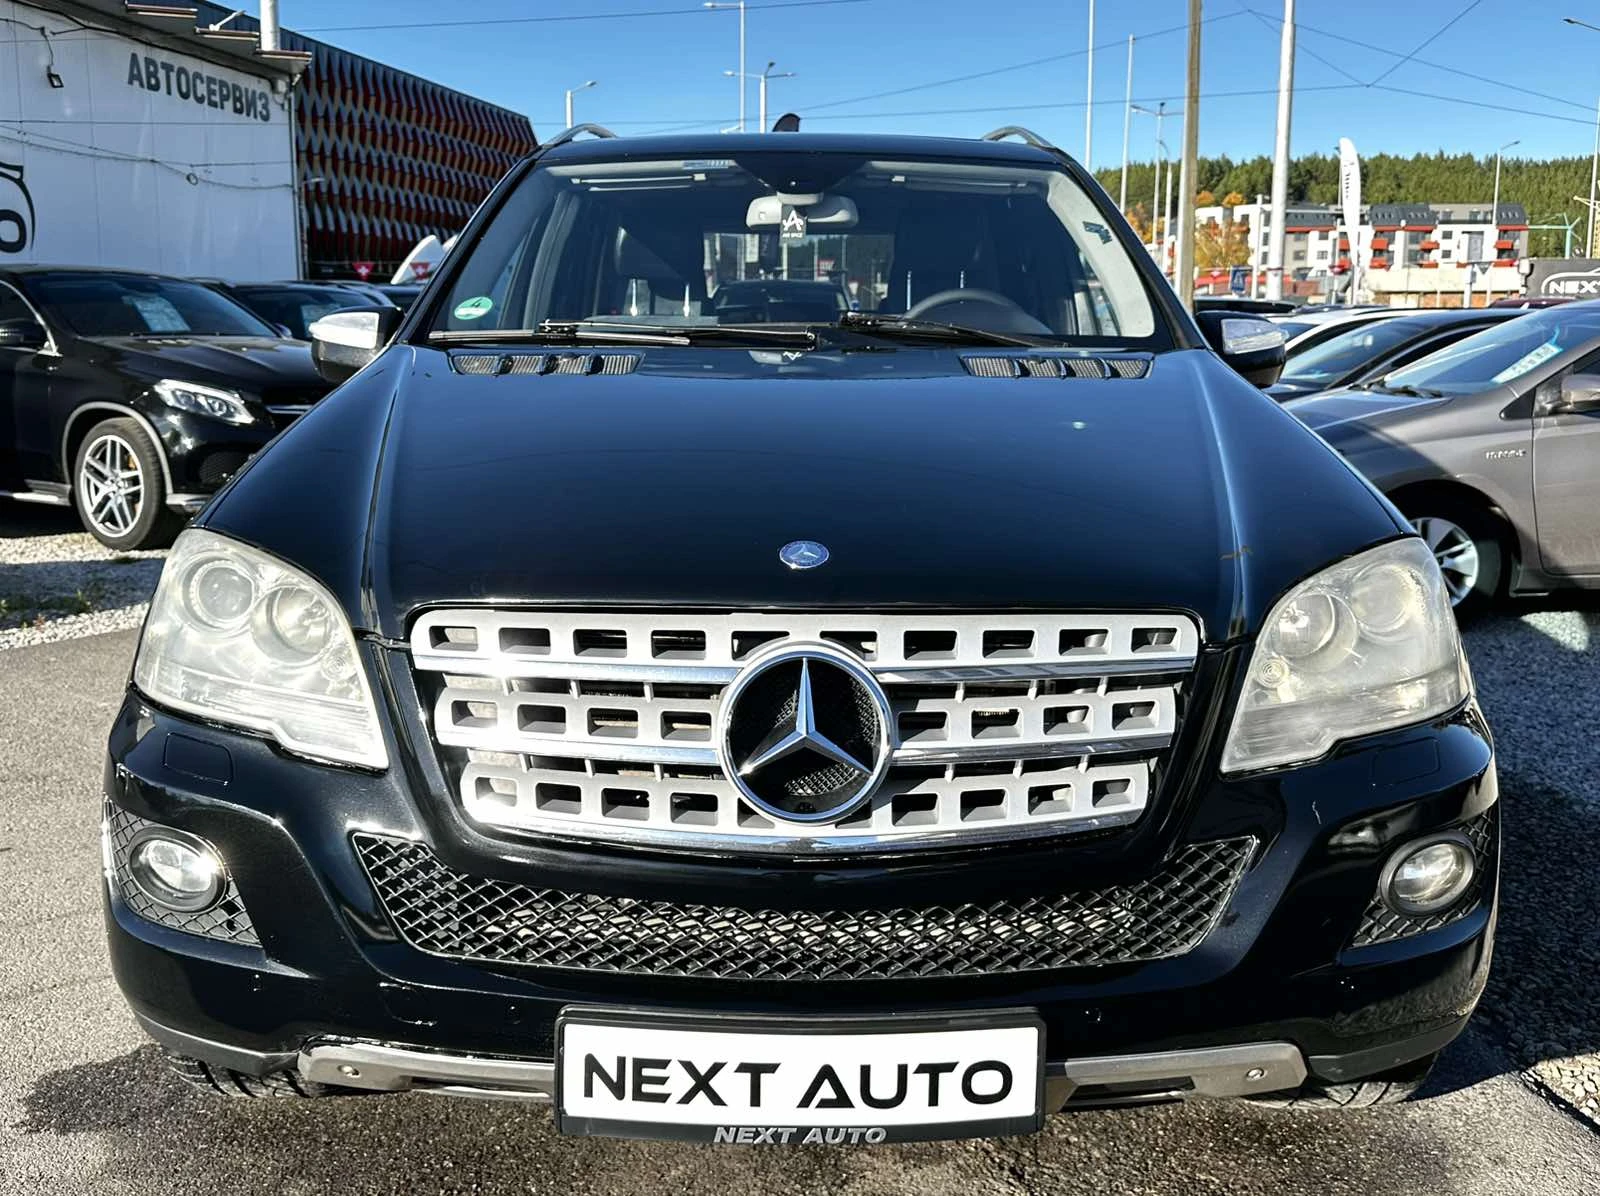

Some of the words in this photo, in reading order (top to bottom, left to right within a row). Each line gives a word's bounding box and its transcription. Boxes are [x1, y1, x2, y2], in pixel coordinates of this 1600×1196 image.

[128, 52, 271, 122] АВТОСЕРВИЗ
[1549, 280, 1600, 294] NEX
[584, 1053, 781, 1107] NEXT
[796, 1060, 1013, 1108] AUTO
[713, 1127, 798, 1144] NEXT
[801, 1127, 887, 1144] AUTO
